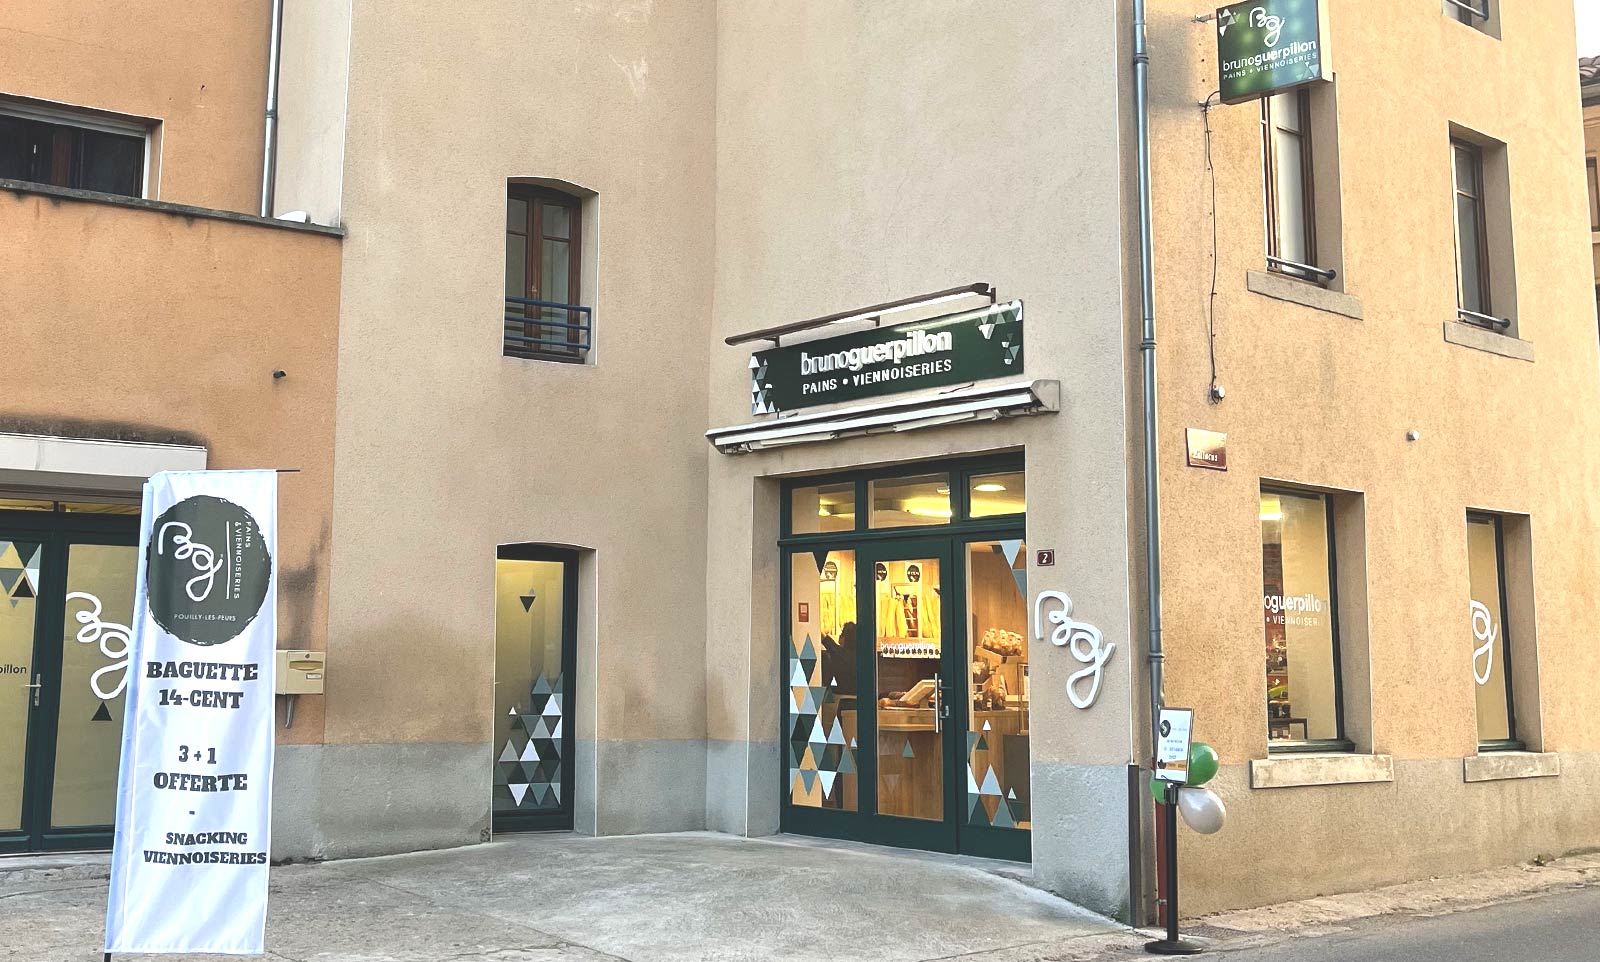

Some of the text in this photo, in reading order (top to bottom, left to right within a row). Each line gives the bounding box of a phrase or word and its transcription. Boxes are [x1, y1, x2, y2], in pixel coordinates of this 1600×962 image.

[1222, 40, 1317, 72] brunoguerpillon
[1223, 52, 1317, 80] PAINS VIENNOISERIES
[801, 329, 952, 376] brunoguerpillon
[802, 359, 952, 395] PAINS VIENNOISERIES
[146, 661, 258, 681] BAGUETTE
[159, 689, 244, 708] 14-CENT
[178, 745, 189, 763] 3
[207, 748, 217, 764] 1
[153, 772, 248, 792] OFFERTE
[165, 831, 248, 846] SNACKING
[143, 850, 267, 865] VIENNOISERIES
